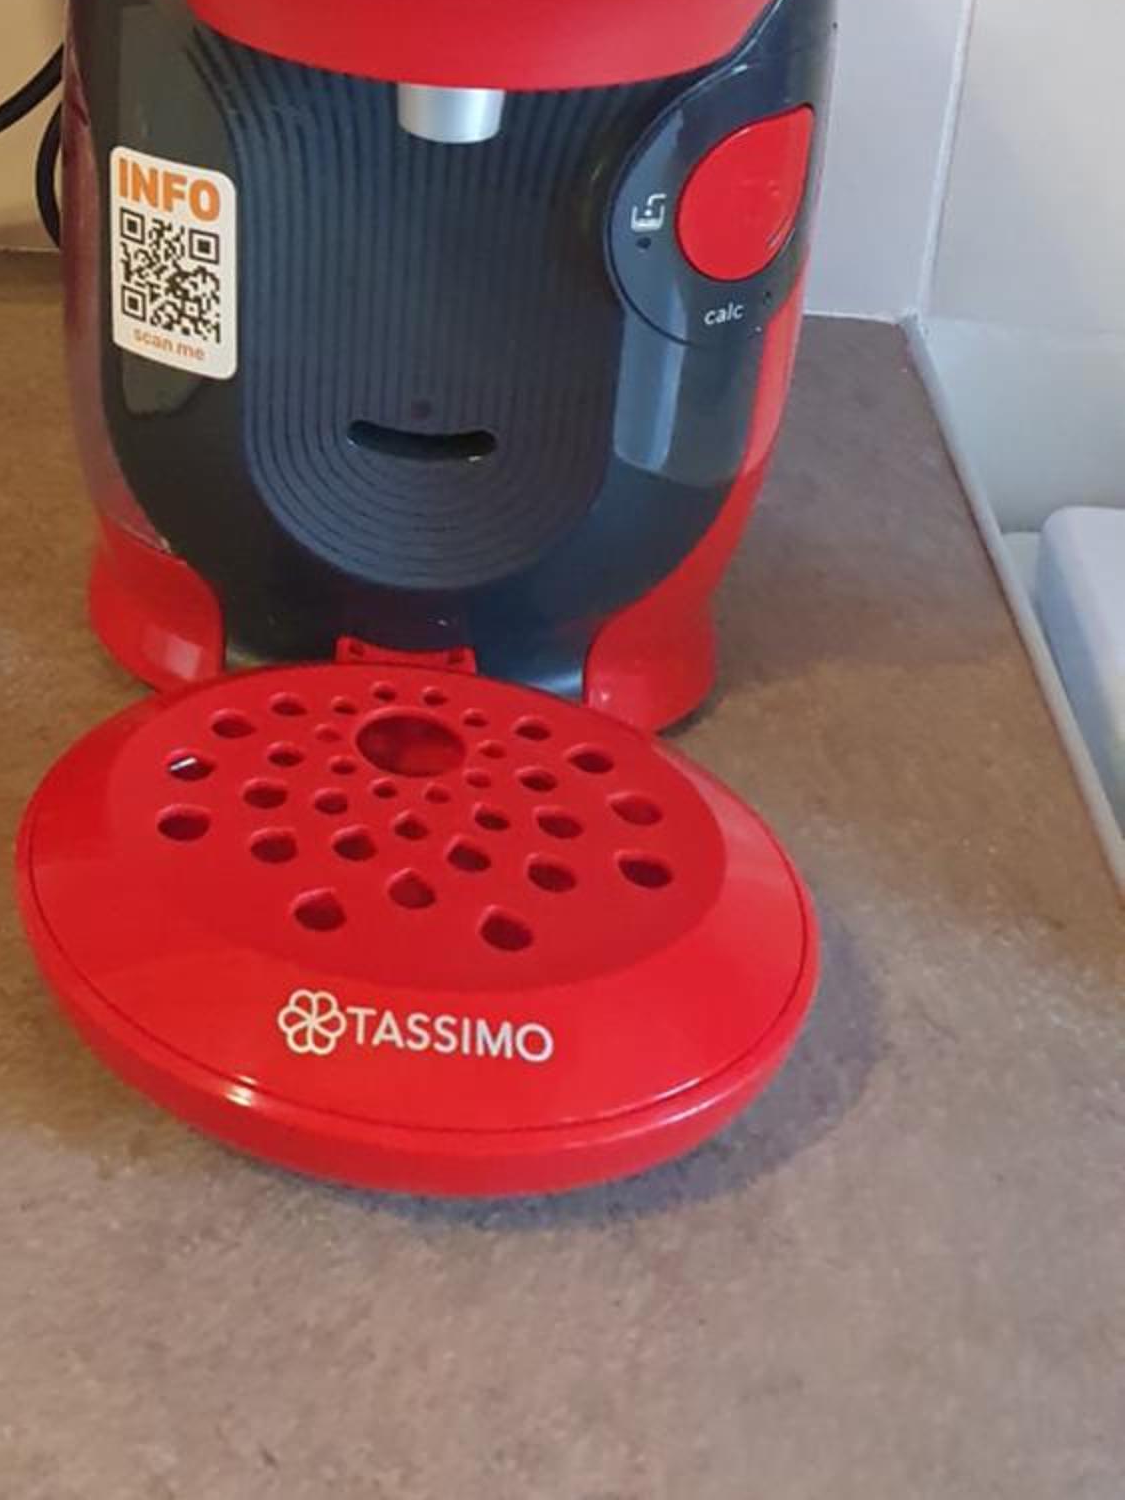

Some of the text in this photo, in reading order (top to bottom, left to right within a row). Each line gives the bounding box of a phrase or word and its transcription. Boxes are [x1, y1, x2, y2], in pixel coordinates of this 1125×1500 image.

[118, 157, 221, 222] INFO
[703, 301, 745, 326] calc
[132, 327, 206, 361] scan me
[346, 1005, 555, 1062] TASSIMO
